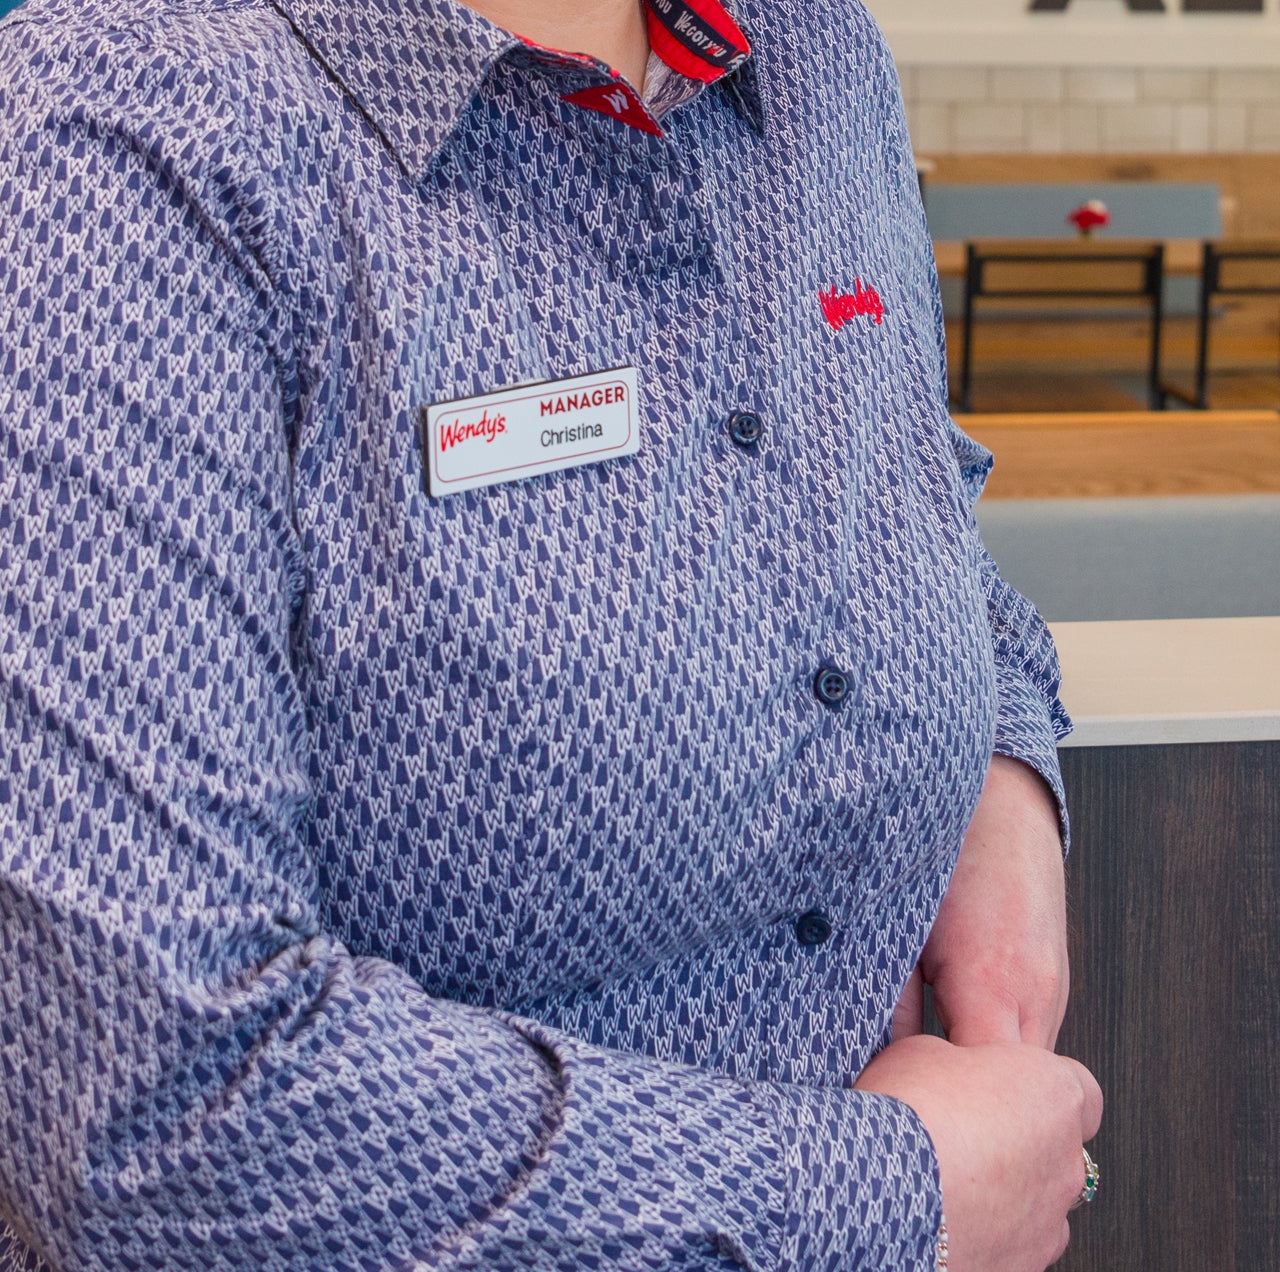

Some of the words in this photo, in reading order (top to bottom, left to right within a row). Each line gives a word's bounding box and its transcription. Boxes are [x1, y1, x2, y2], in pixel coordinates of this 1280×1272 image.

[540, 385, 625, 417] MANAGER
[440, 409, 506, 452] Wendy's
[540, 423, 604, 447] Christina
